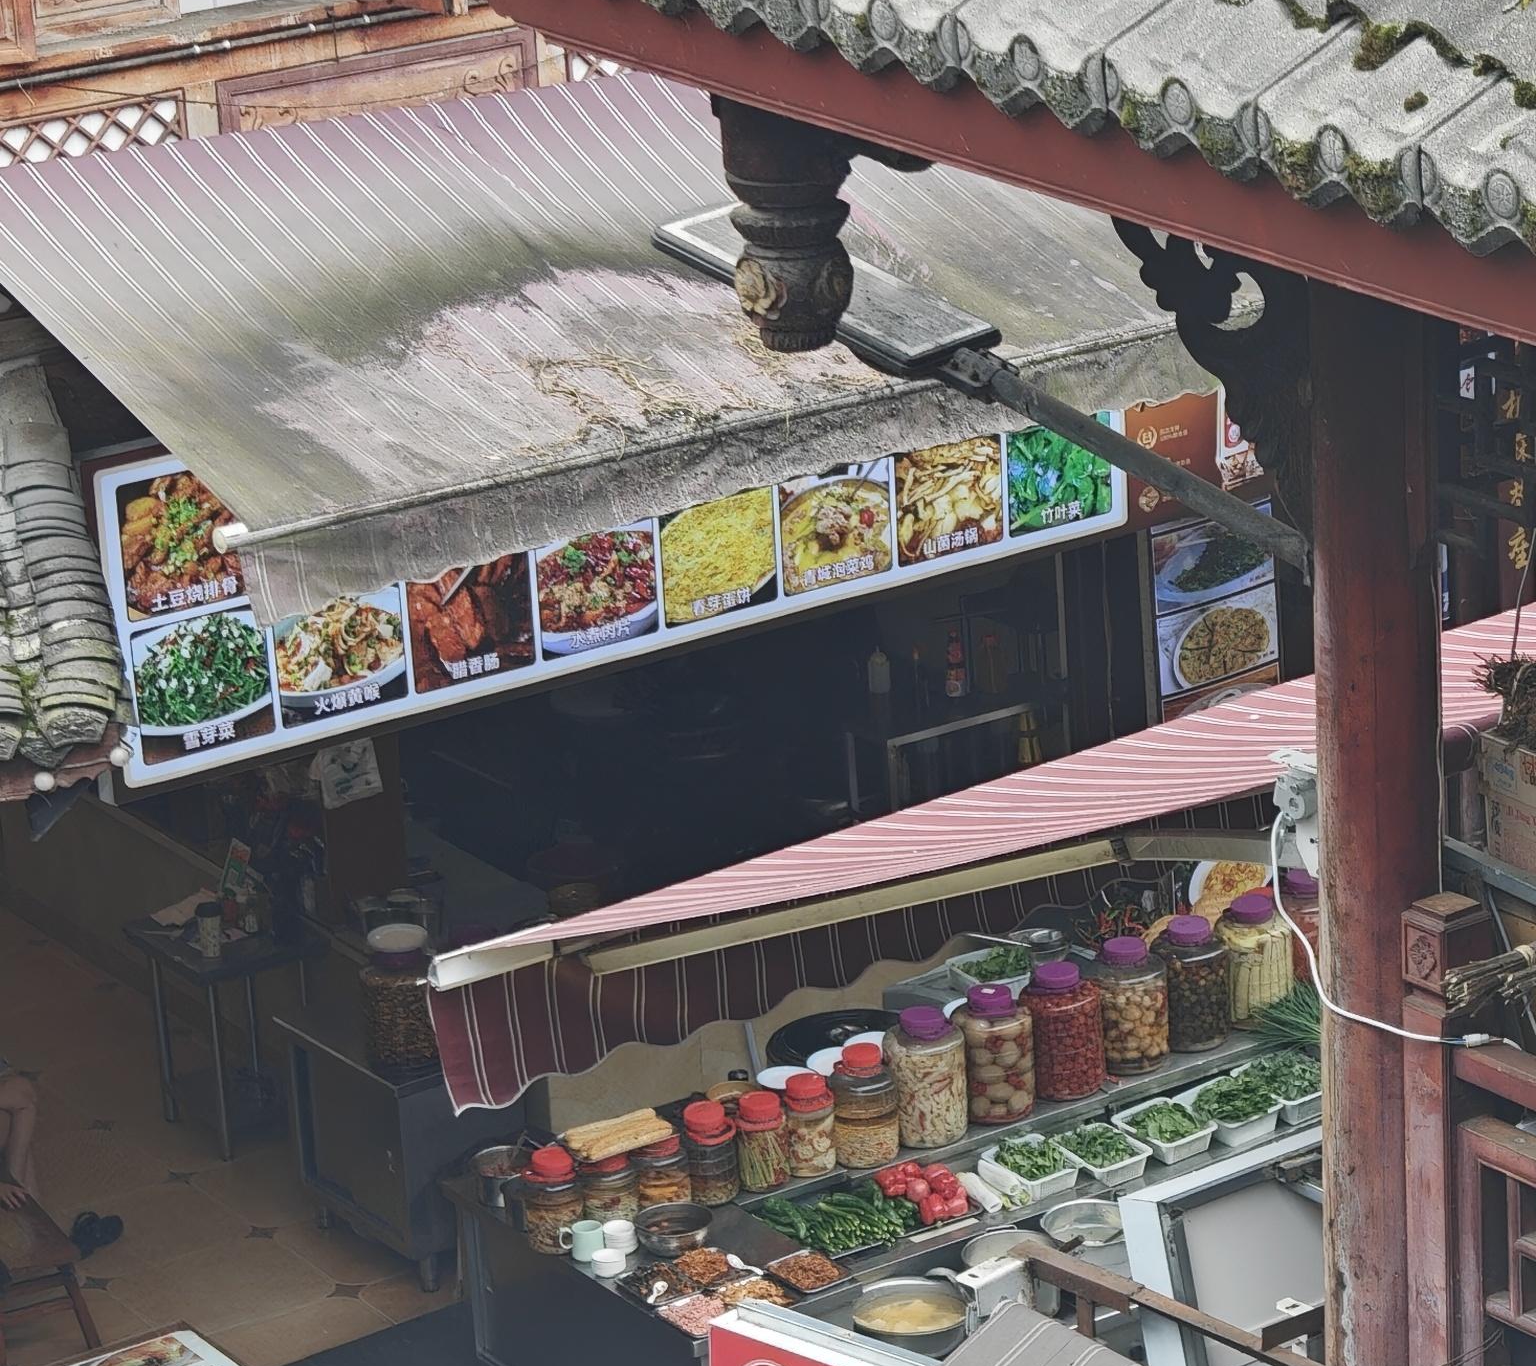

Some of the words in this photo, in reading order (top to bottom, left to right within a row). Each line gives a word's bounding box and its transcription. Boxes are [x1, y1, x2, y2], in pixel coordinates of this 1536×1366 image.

[1040, 500, 1082, 524] 竹叶菜
[923, 526, 979, 557] 山菌汤锅
[151, 575, 239, 612] 土豆烧排骨
[570, 617, 632, 649] 水煮肉片
[314, 683, 381, 716] 火爆黄喉
